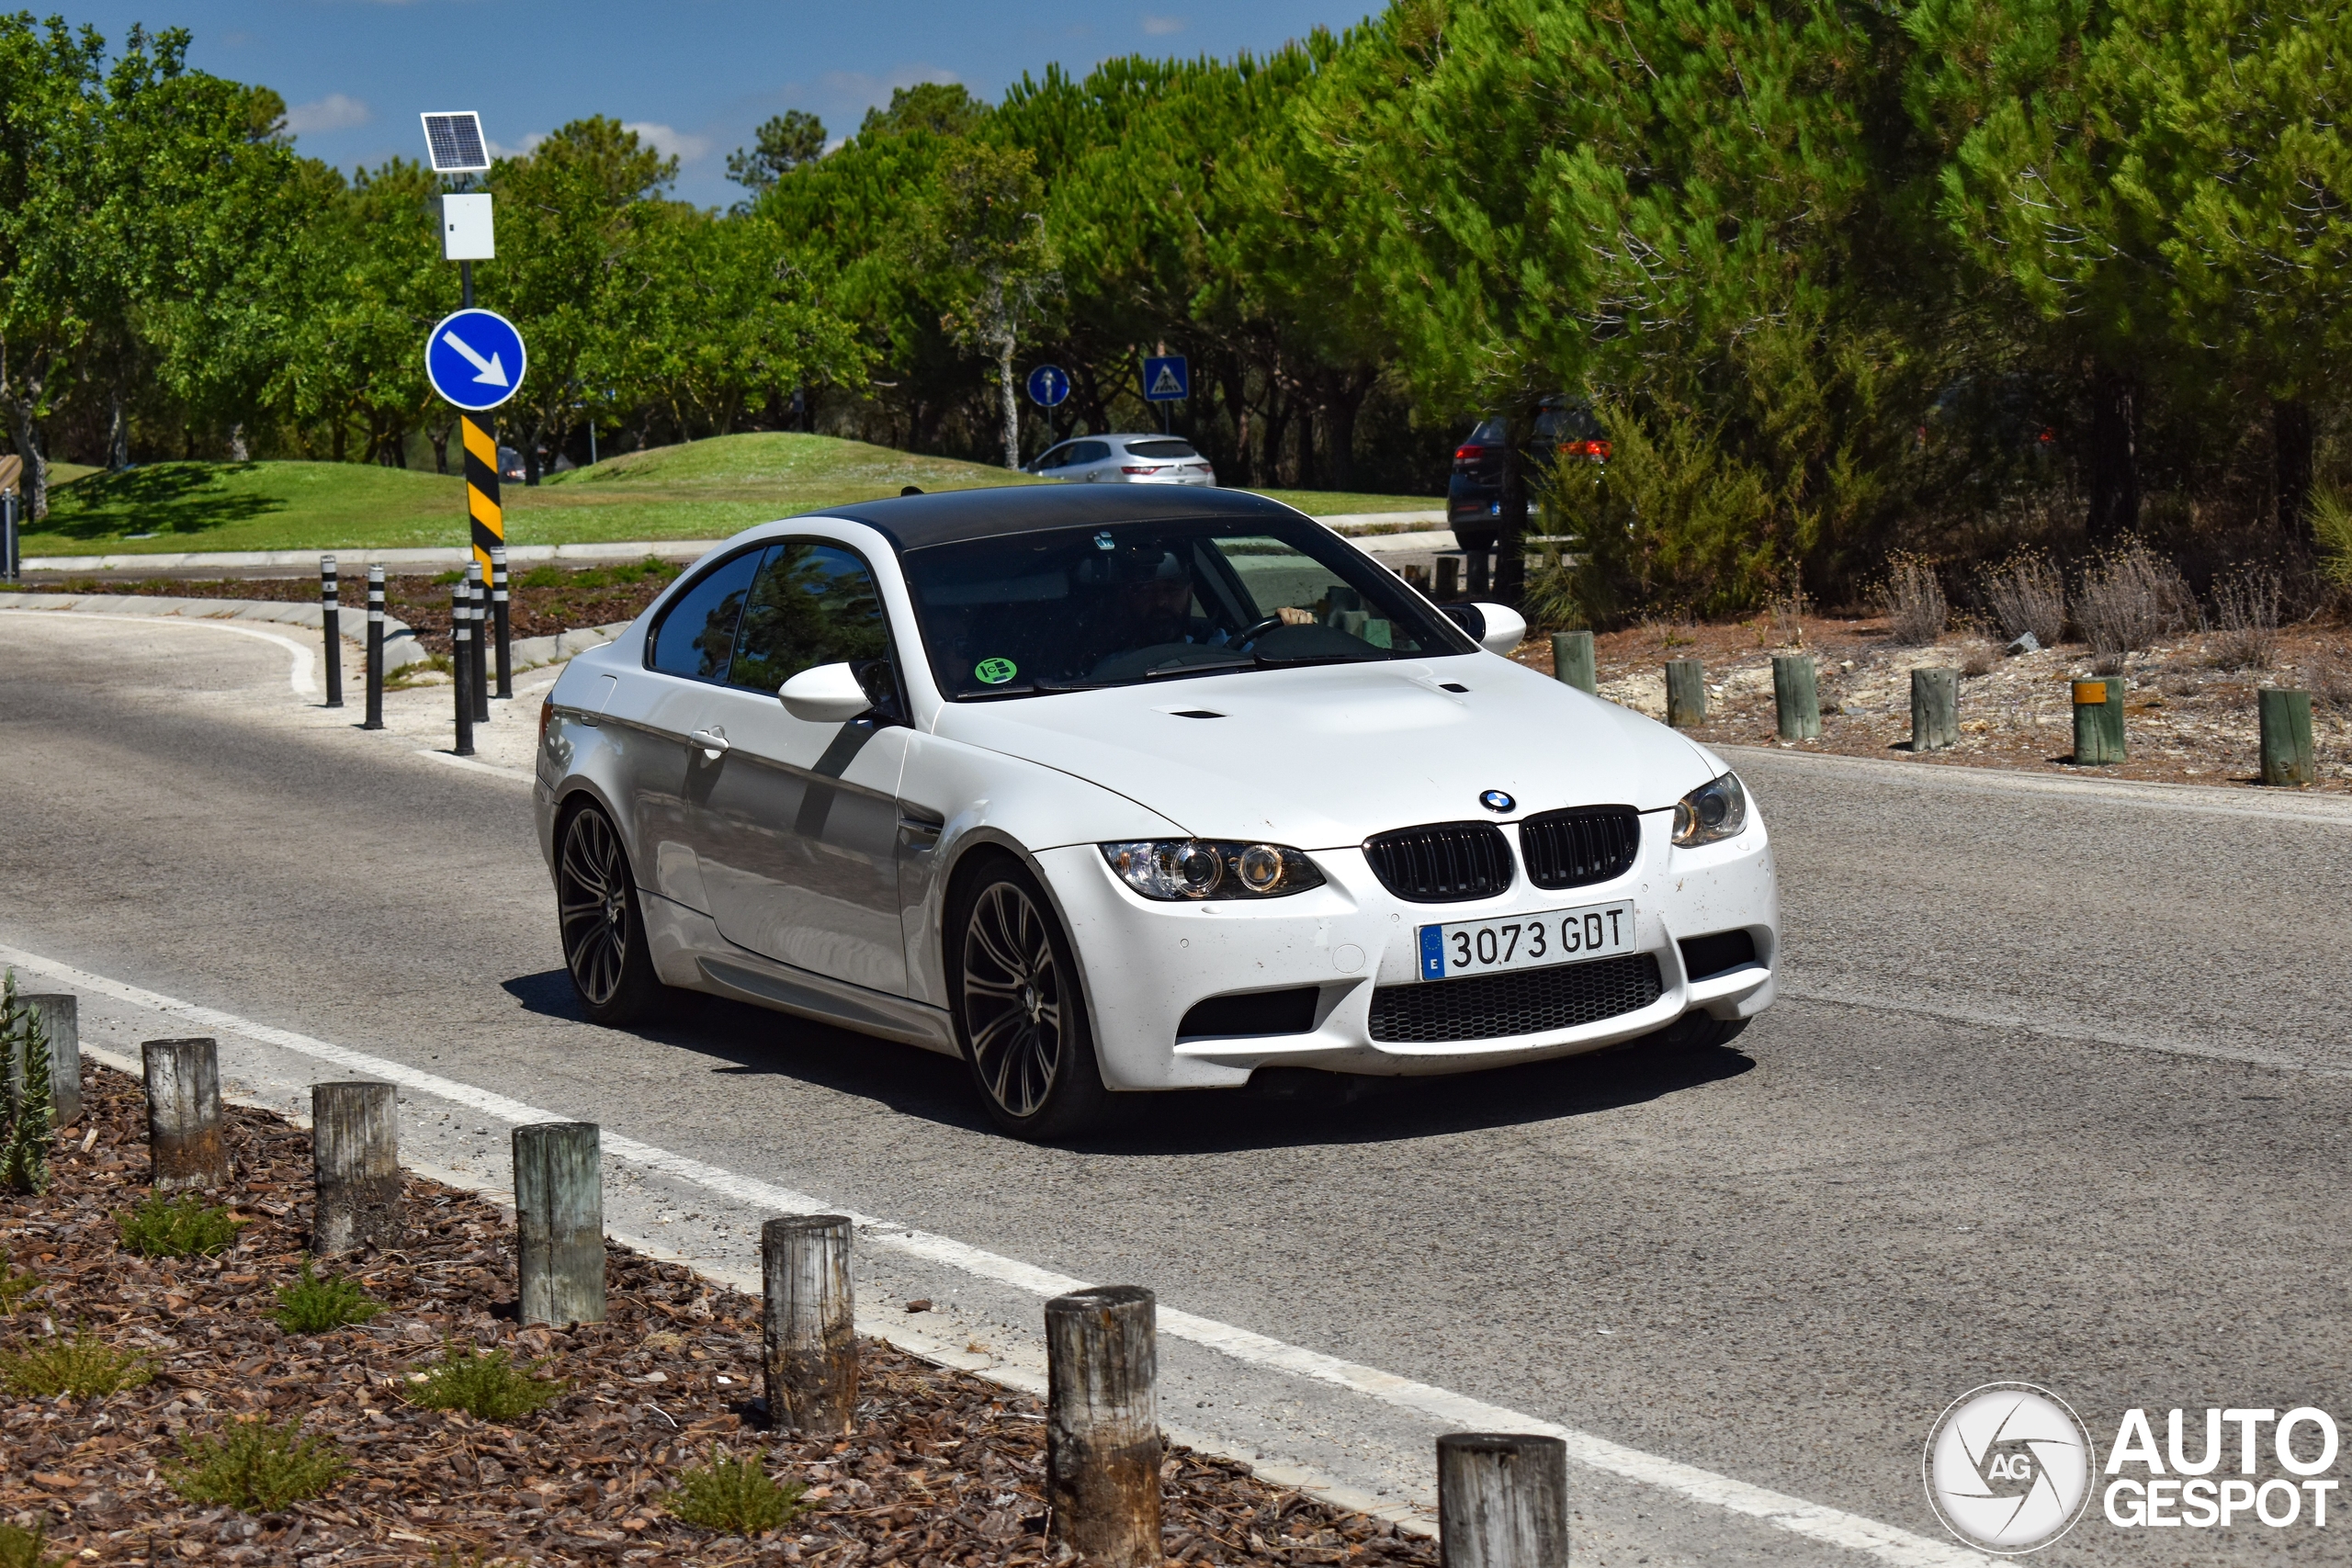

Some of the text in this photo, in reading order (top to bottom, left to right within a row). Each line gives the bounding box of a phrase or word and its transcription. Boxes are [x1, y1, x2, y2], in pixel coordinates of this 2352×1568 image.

[1452, 908, 1623, 967] 3073 GDT
[1430, 958, 1438, 970] E
